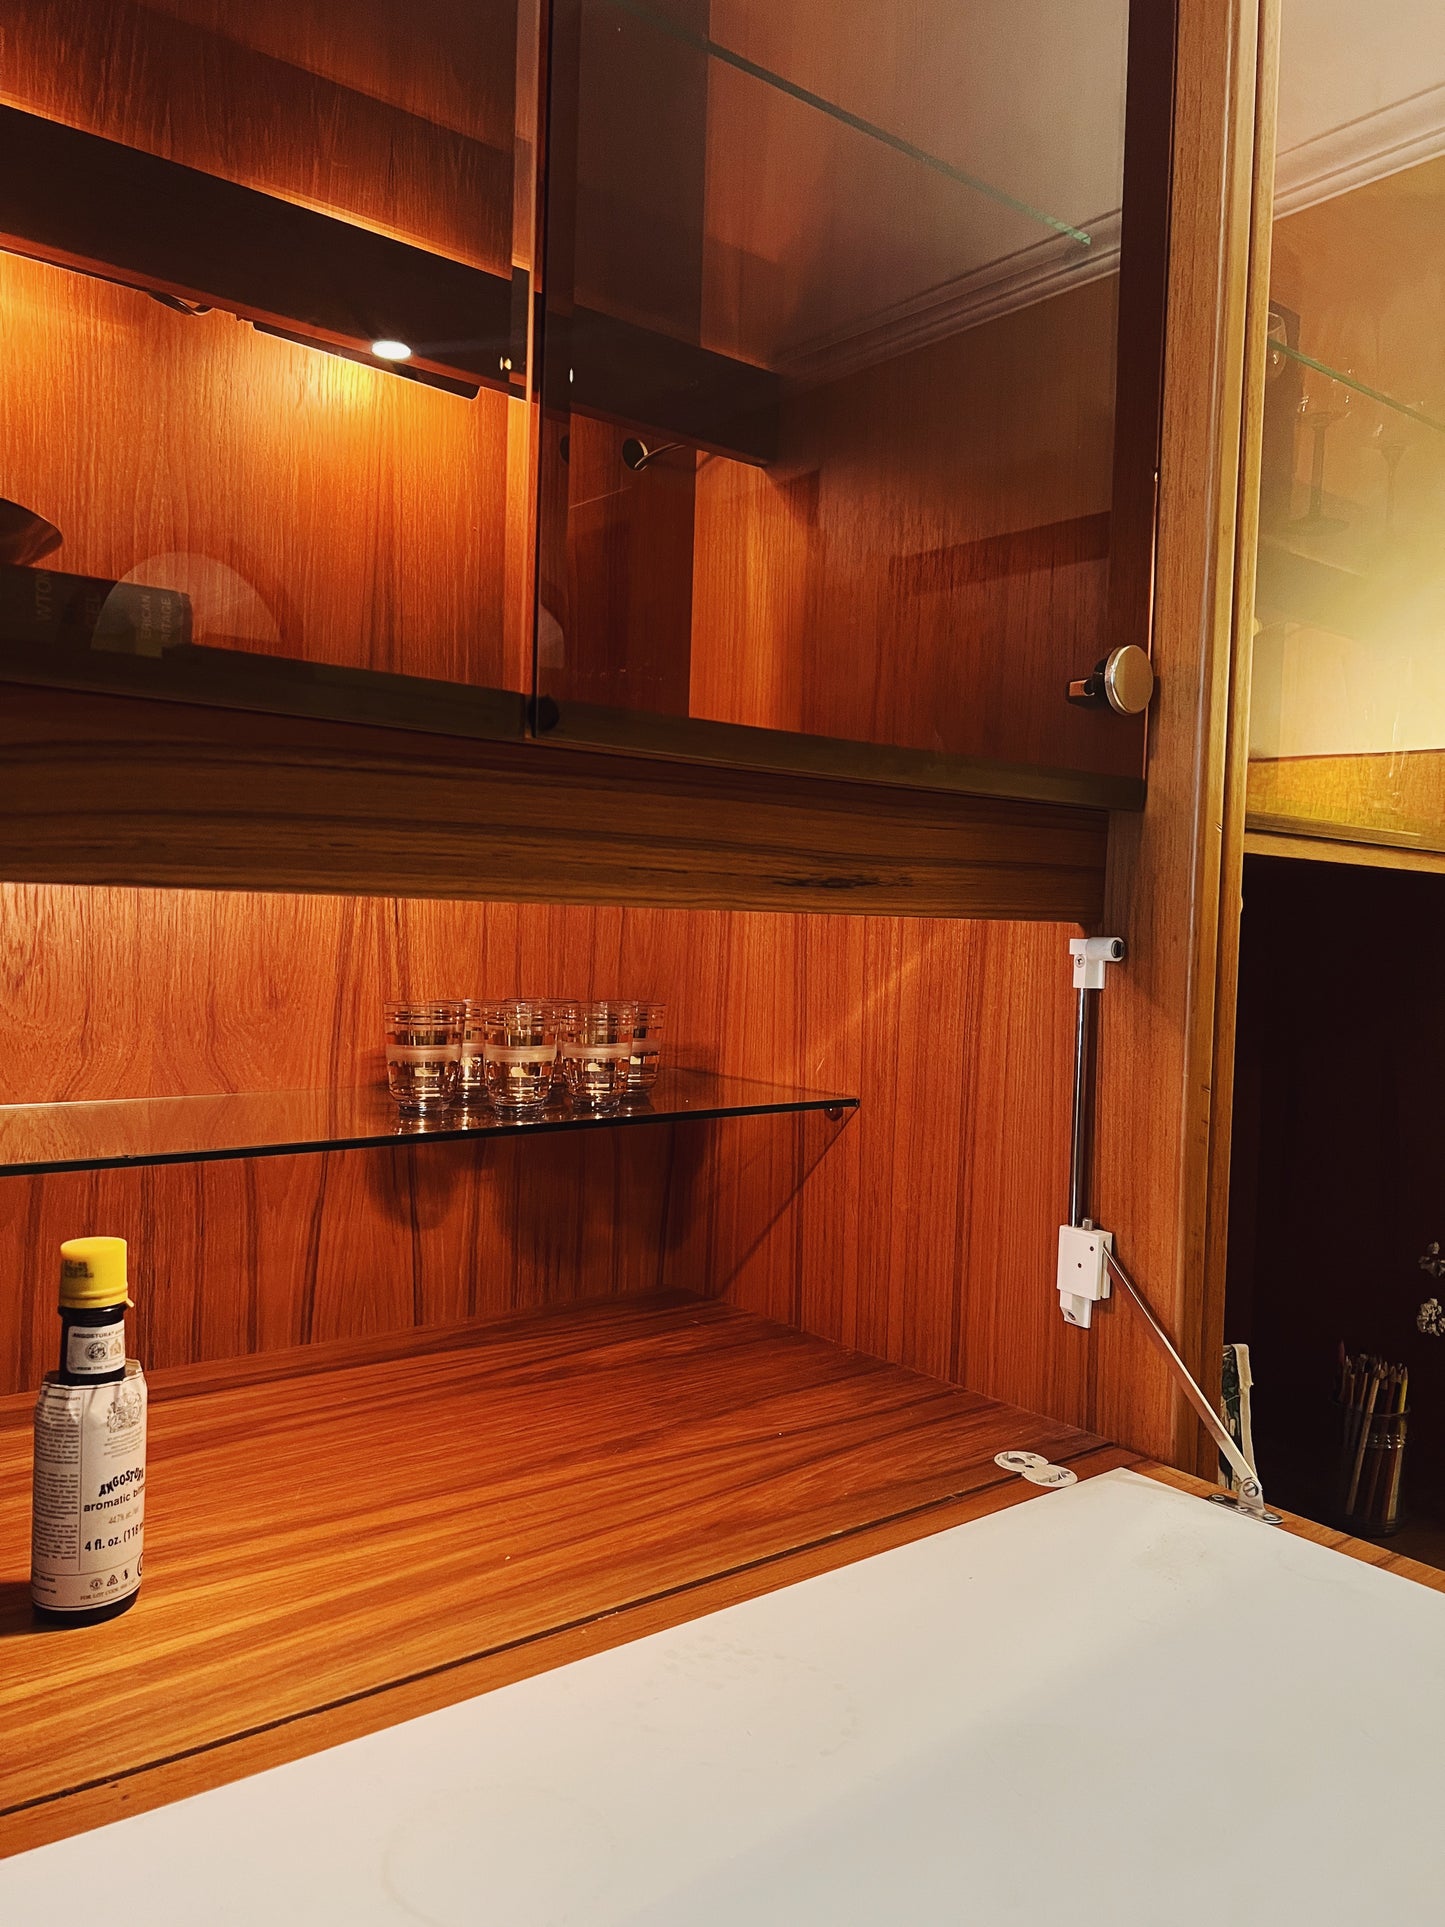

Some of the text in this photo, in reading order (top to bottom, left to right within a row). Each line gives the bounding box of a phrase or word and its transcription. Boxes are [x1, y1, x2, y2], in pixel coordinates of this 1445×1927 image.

[83, 1493, 131, 1512] aromatic
[84, 1541, 91, 1551] 4
[94, 1538, 105, 1550] fl.
[108, 1536, 122, 1547] oz.
